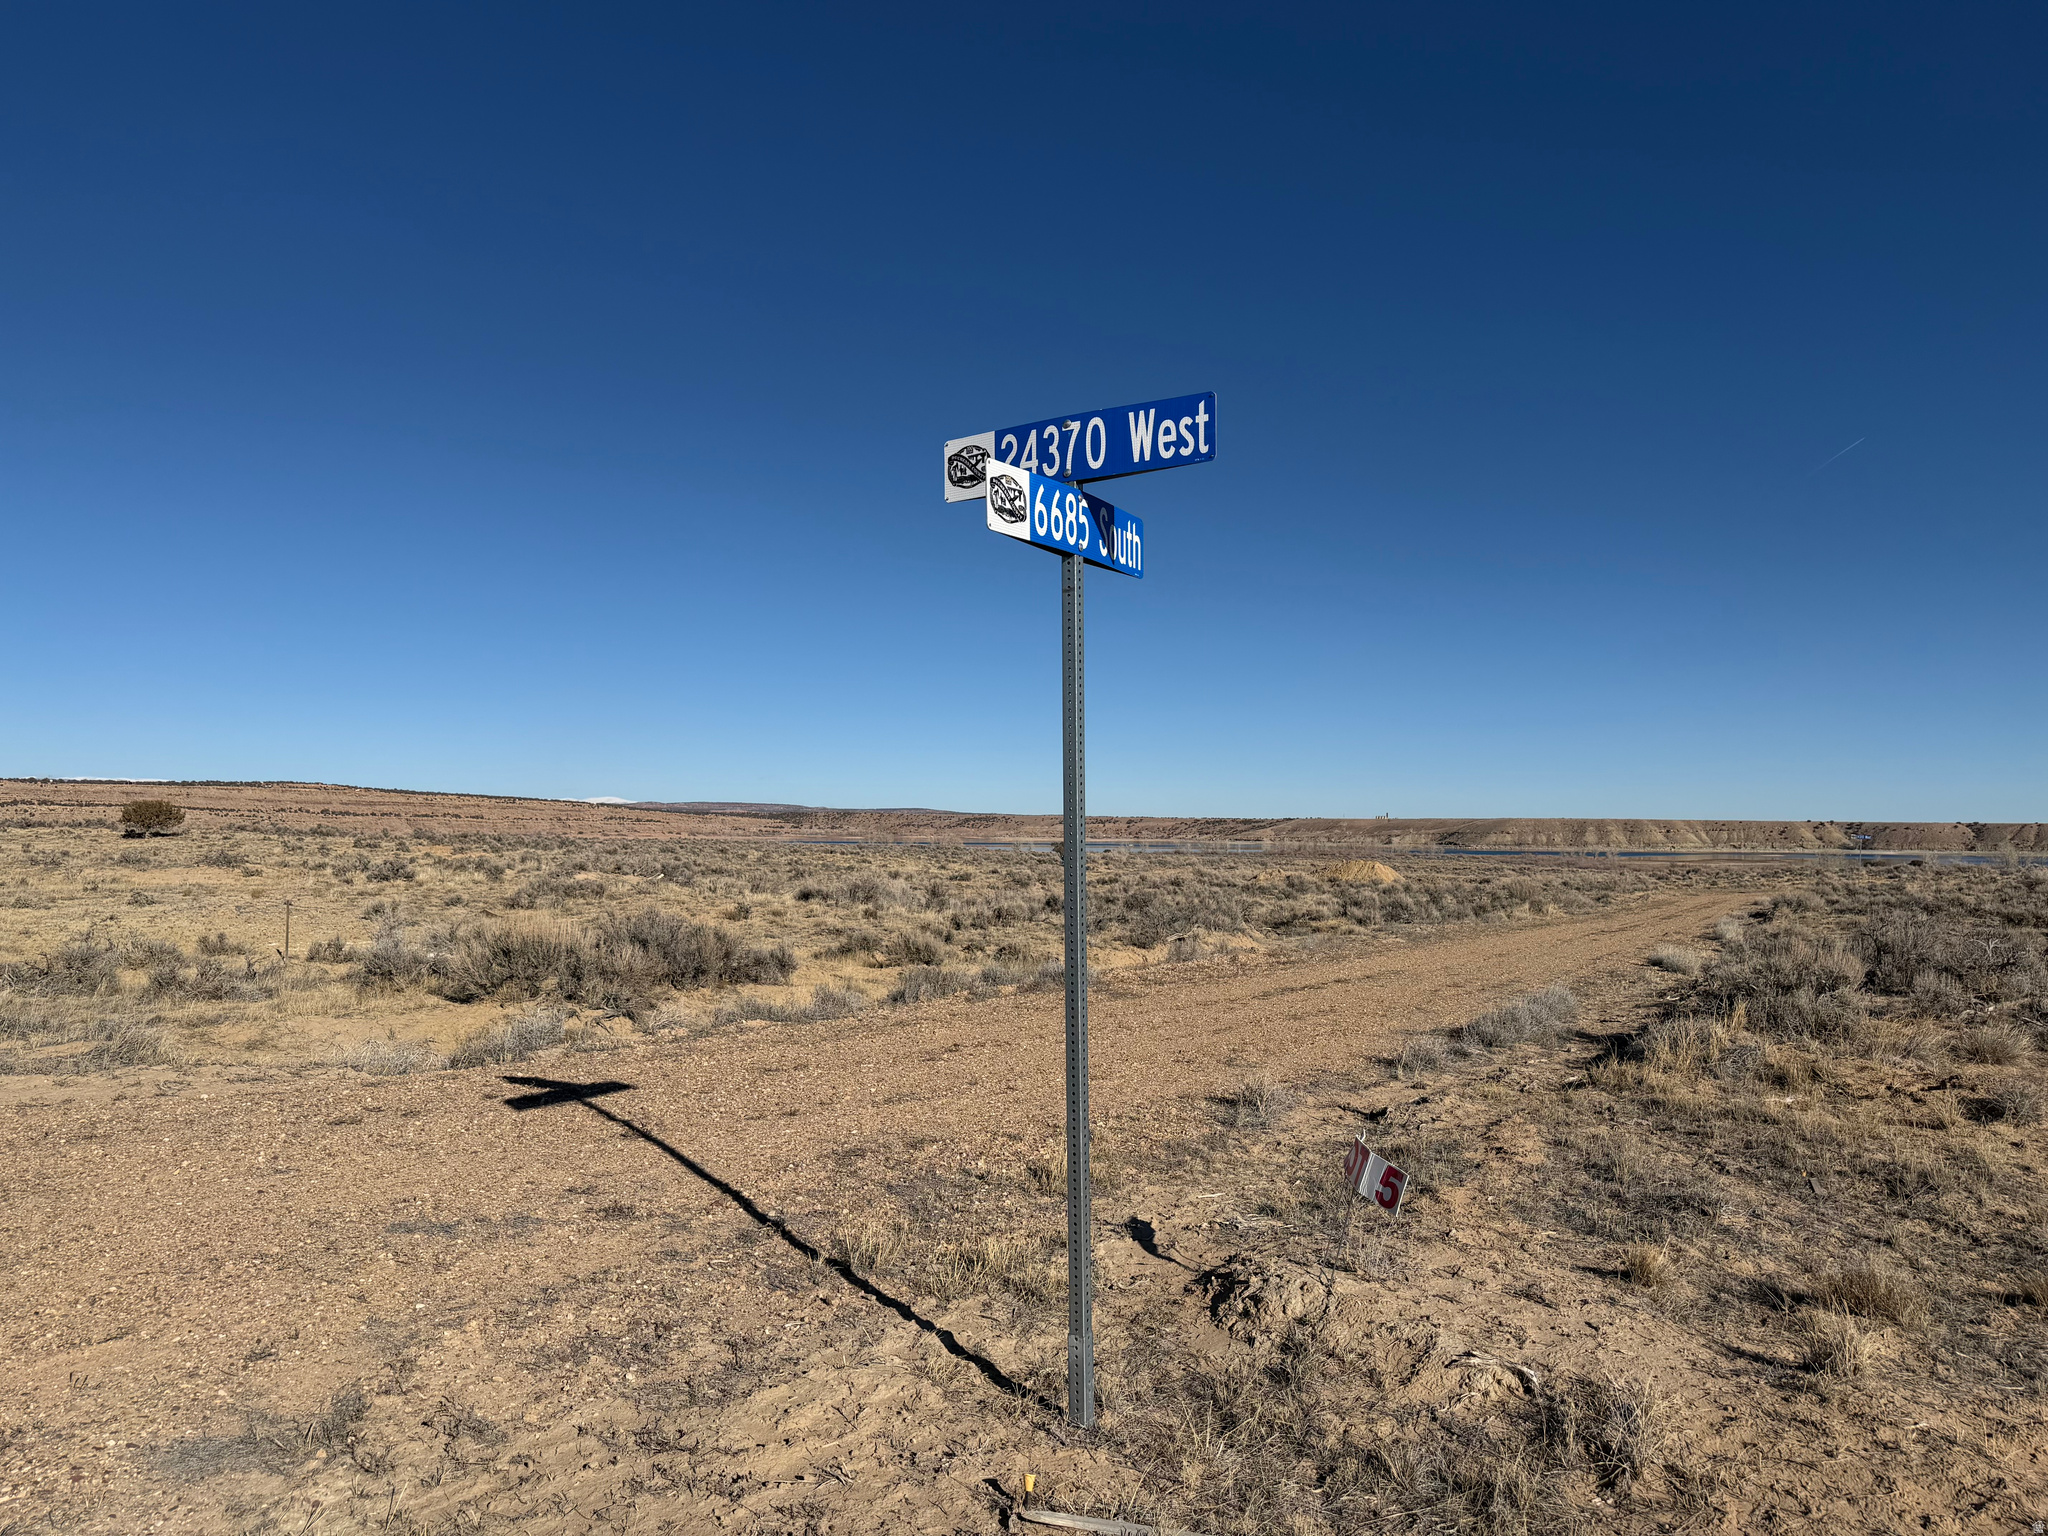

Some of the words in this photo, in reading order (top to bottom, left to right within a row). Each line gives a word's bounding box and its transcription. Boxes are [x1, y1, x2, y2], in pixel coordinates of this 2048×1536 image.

[1001, 416, 1106, 477] 24370
[1128, 399, 1209, 463] West
[1034, 484, 1090, 550] 6685
[1099, 506, 1142, 571] South
[1375, 1165, 1404, 1210] 5
